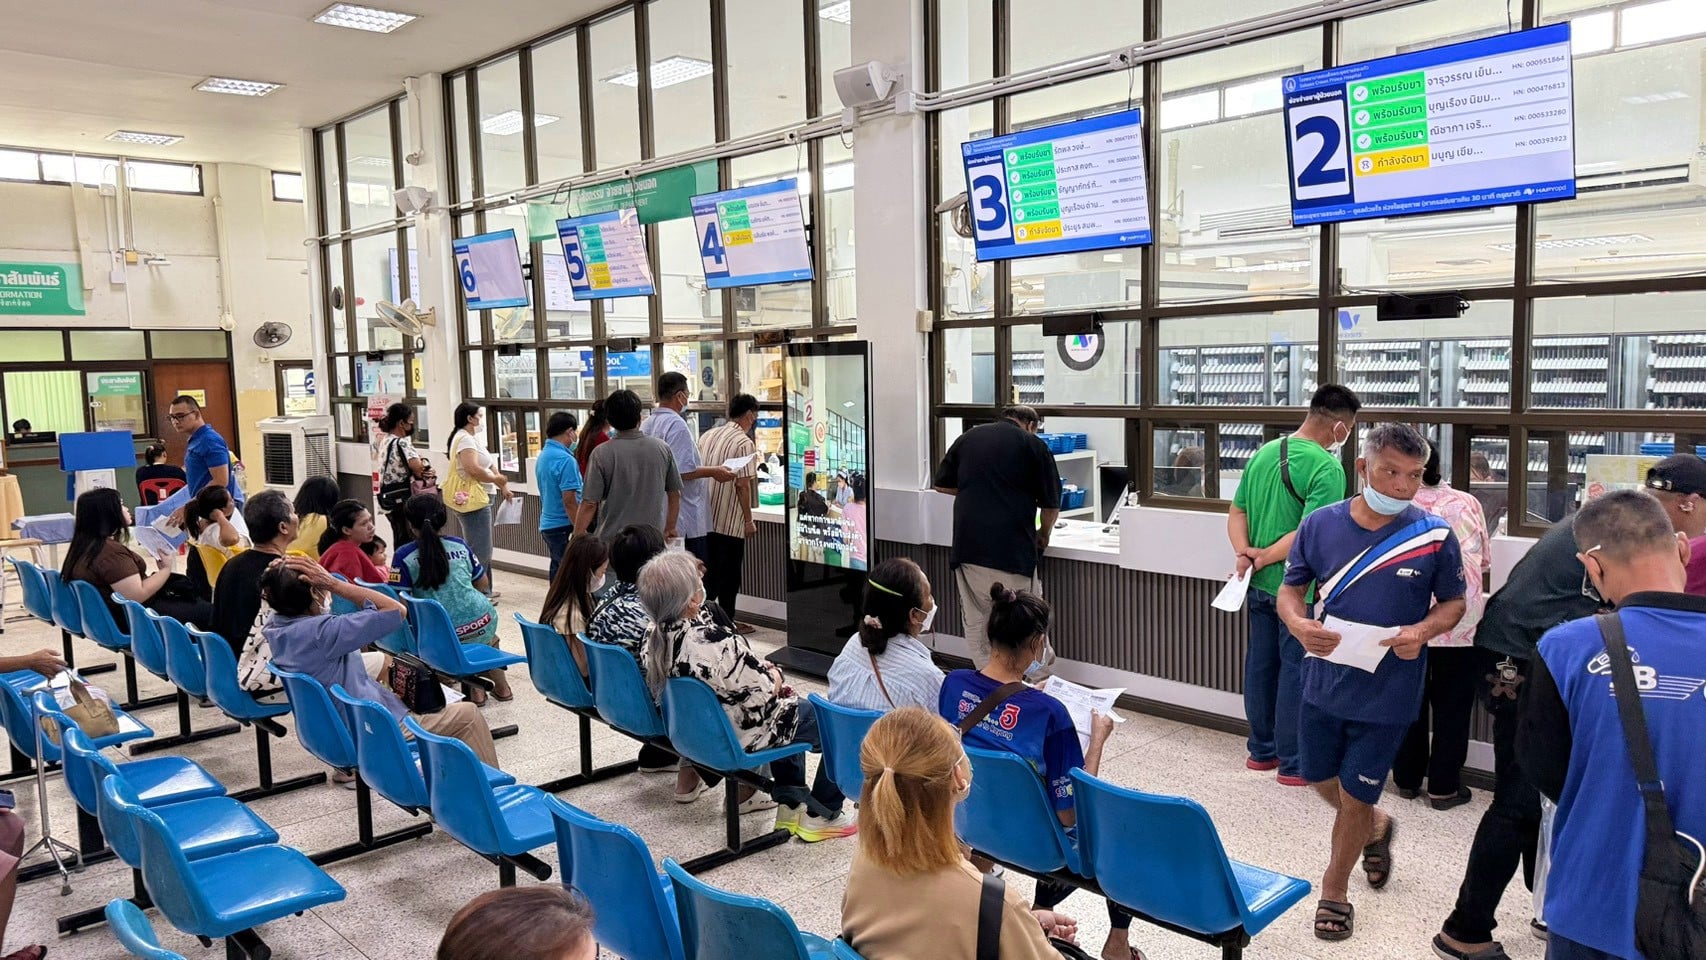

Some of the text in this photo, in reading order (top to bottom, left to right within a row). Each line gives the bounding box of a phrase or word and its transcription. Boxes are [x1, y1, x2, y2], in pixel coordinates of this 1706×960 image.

[1372, 80, 1421, 96] พร้อมรับยา
[1427, 71, 1472, 87] จารุวรรณ
[1373, 105, 1423, 120] พร้อมรับยา
[1375, 130, 1424, 144] พร้อมรับยา
[1295, 115, 1346, 187] 2
[1377, 154, 1424, 168] กำลังจัดยา
[972, 174, 1007, 231] 3
[702, 222, 725, 264] 4
[565, 243, 584, 280] 5
[461, 259, 475, 292] 6
[456, 614, 491, 636] SPORT
